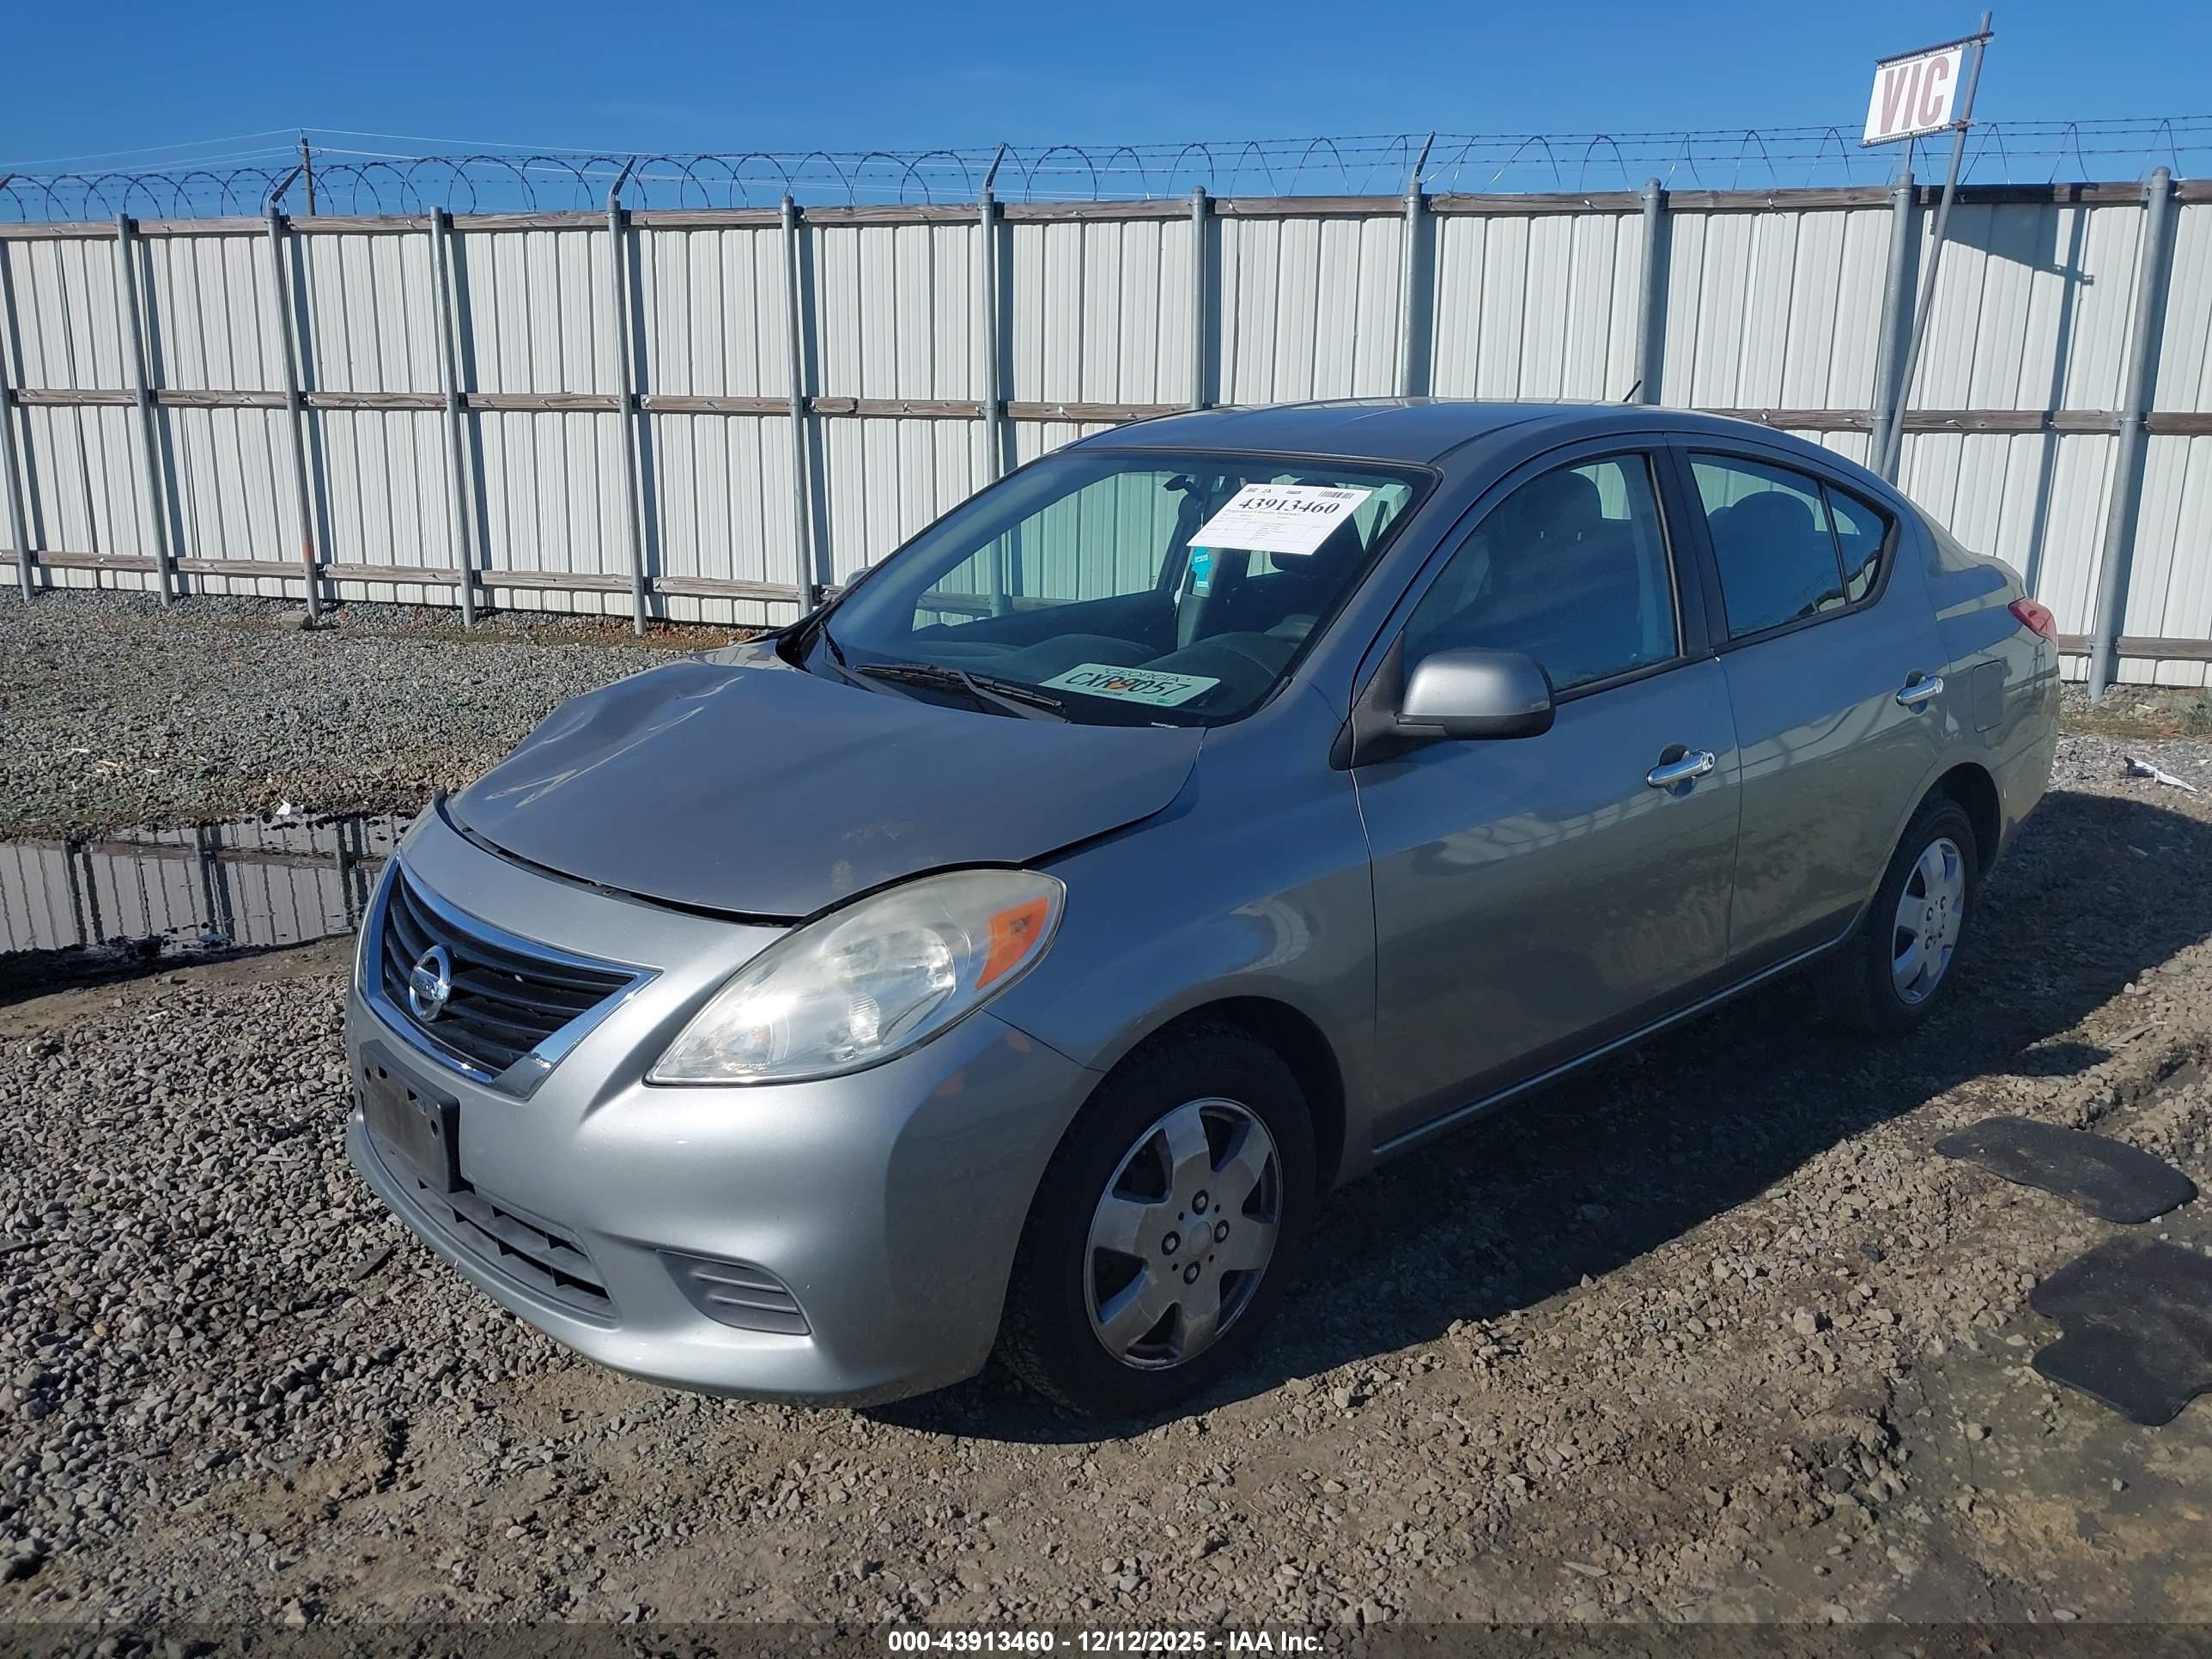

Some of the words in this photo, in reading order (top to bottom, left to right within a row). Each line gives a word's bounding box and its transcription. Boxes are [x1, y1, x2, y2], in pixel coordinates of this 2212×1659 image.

[1880, 56, 1949, 135] VIC
[1238, 497, 1340, 514] 43913460
[1065, 672, 1192, 696] CXR9057
[1106, 668, 1179, 683] GEORGIA
